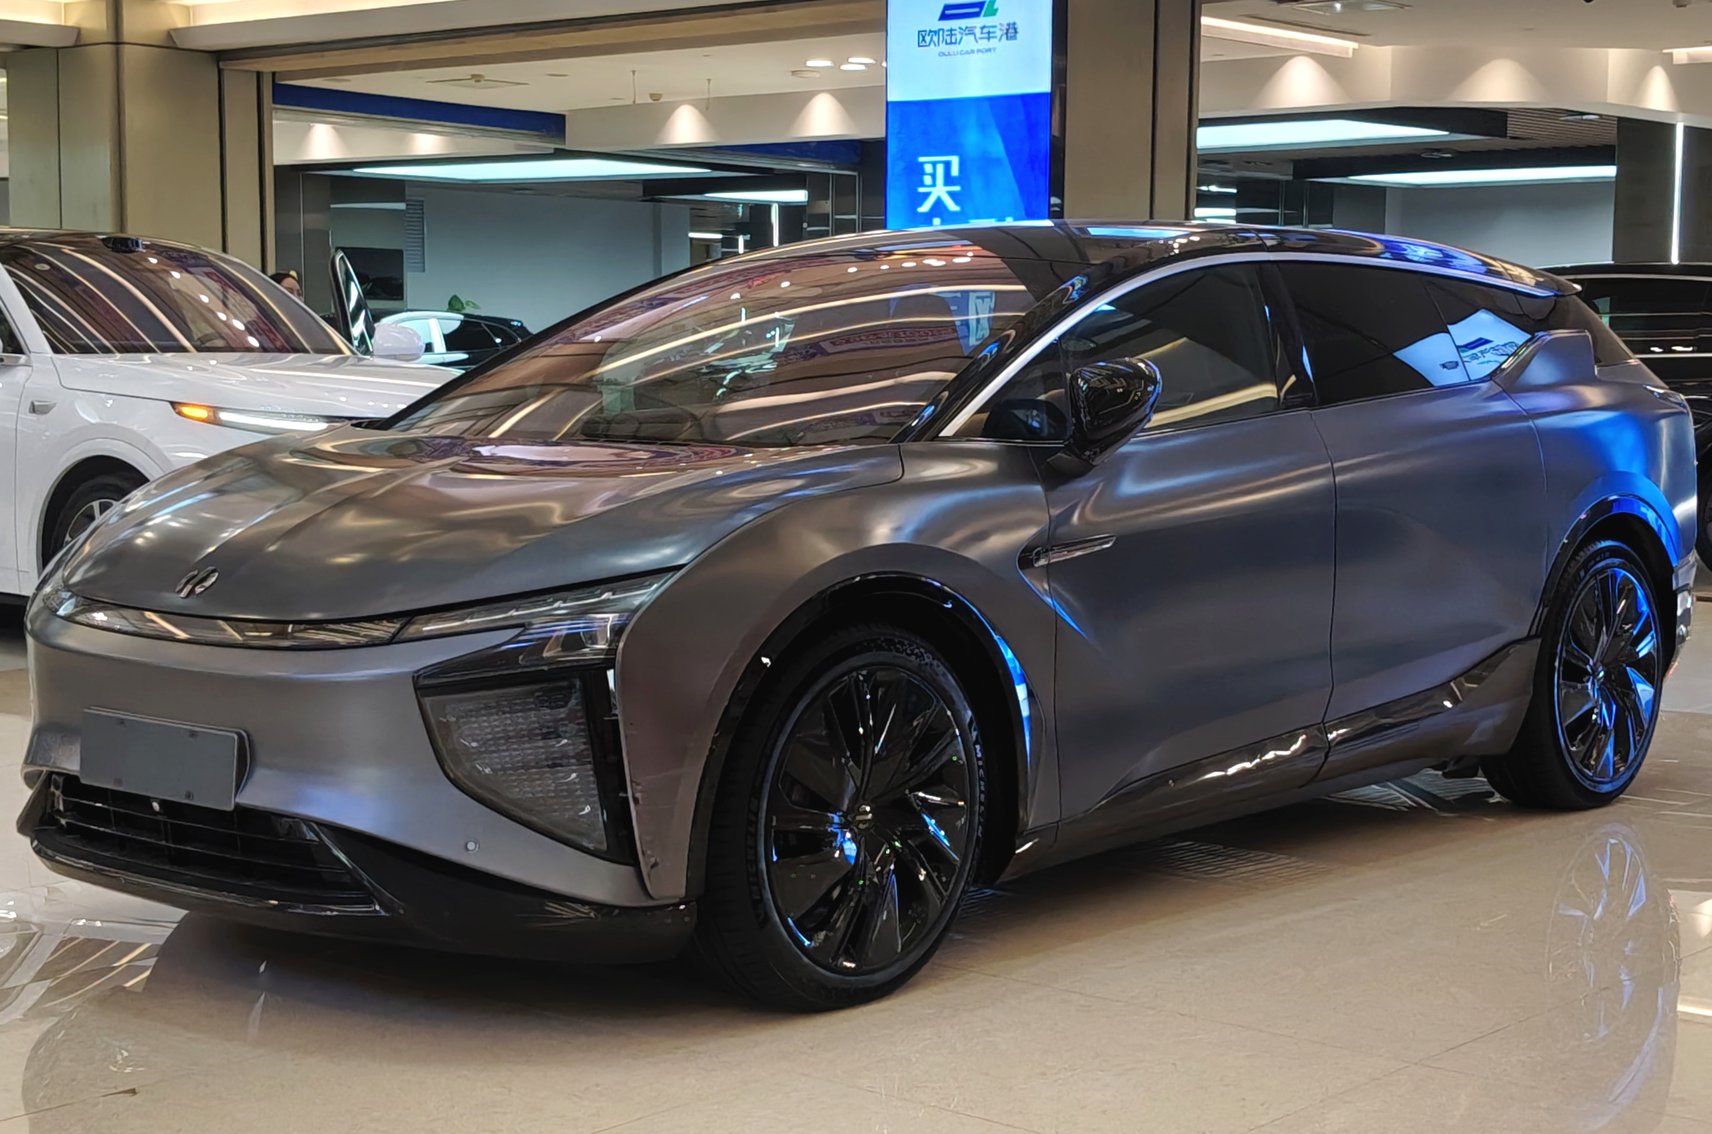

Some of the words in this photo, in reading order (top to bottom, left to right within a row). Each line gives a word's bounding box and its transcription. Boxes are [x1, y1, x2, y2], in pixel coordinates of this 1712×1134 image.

[917, 22, 1019, 47] 欧陆汽车港
[916, 155, 961, 213] 买
[975, 744, 985, 838] MICHELIN
